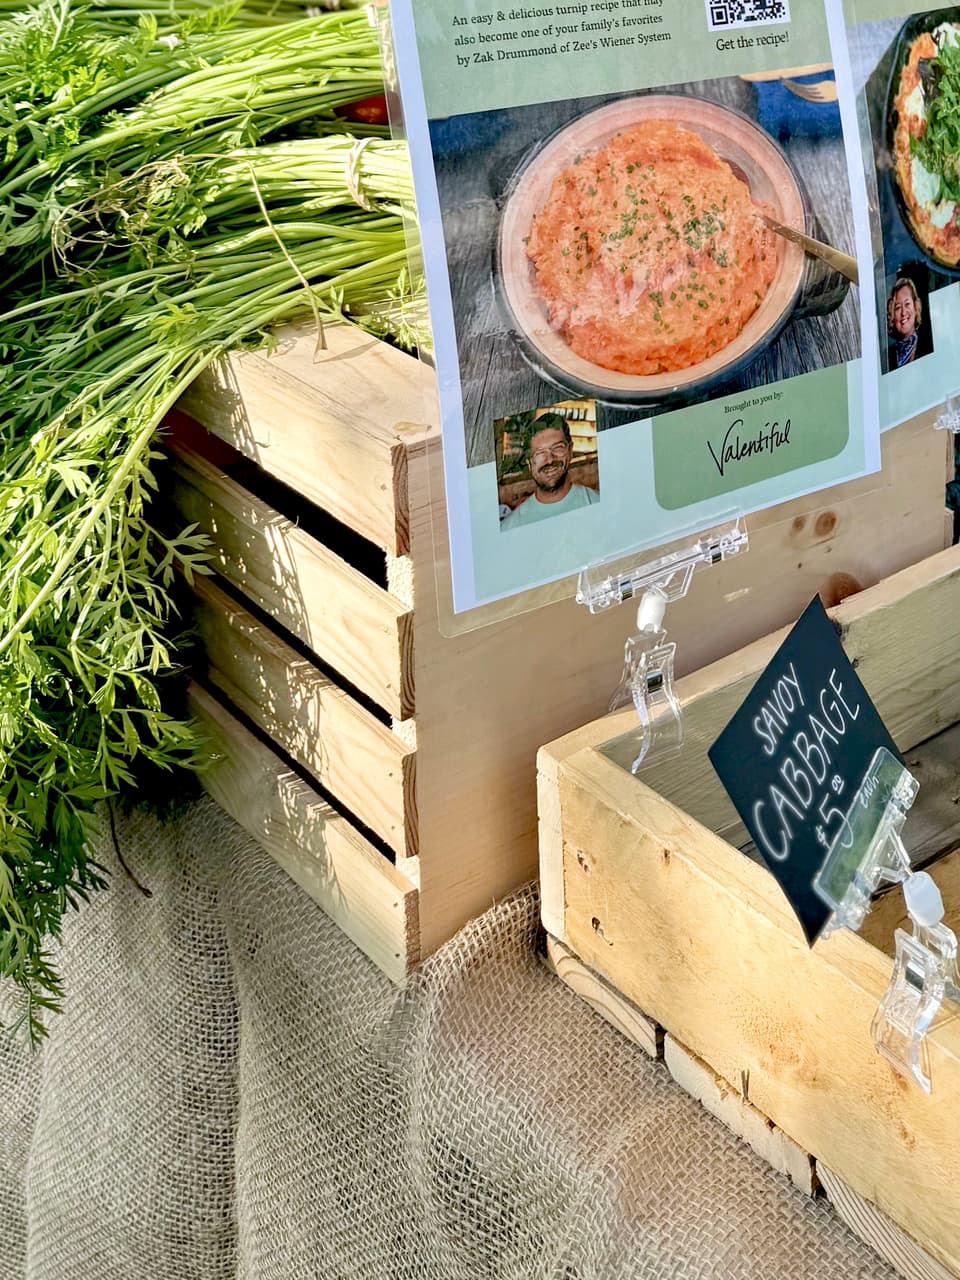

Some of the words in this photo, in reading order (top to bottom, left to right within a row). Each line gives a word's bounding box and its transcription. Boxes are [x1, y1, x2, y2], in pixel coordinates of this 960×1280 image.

[452, 15, 468, 26] An
[471, 13, 494, 26] easy
[496, 10, 506, 22] &
[508, 8, 554, 21] delicious
[555, 2, 588, 16] turnip
[590, 0, 620, 13] recipe
[454, 34, 476, 46] also
[478, 32, 519, 44] become
[521, 28, 540, 39] one
[542, 24, 553, 36] of
[555, 24, 579, 38] your
[581, 18, 620, 32] family's
[622, 13, 664, 27] favorites
[456, 54, 471, 68] by
[473, 50, 495, 64] Zak
[497, 42, 558, 62] Drummond
[560, 40, 571, 53] of
[572, 38, 598, 52] Zee's
[600, 36, 636, 48] Wiener
[637, 31, 672, 46] System
[715, 38, 735, 51] Get
[737, 34, 755, 49] the
[756, 31, 790, 48] recipe!
[724, 399, 751, 414] Brought
[752, 398, 760, 406] to
[760, 394, 773, 406] you
[706, 418, 792, 477] Valentiful
[753, 661, 805, 756] SAVOY
[753, 667, 861, 861] CABBAGE
